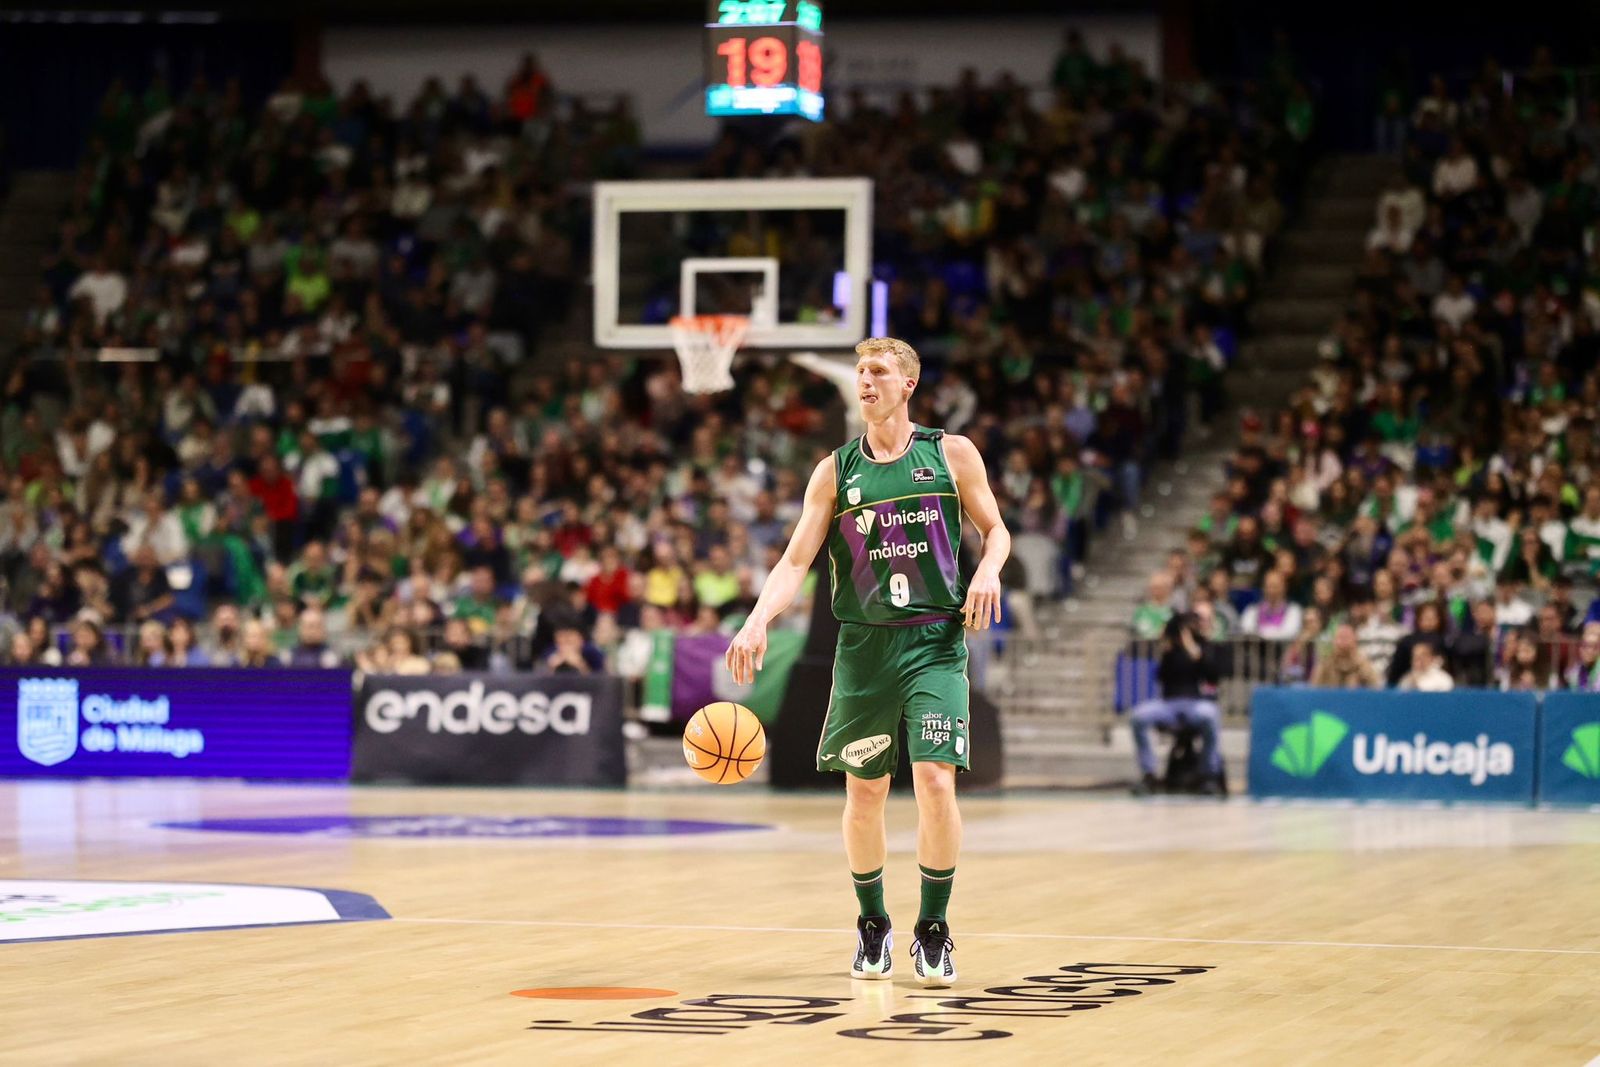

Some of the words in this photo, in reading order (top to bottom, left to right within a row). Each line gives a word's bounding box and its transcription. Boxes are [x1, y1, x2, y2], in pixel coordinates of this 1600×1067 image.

[717, 36, 788, 87] 19
[880, 506, 939, 528] Unicaja
[869, 541, 929, 561] málaga
[889, 573, 910, 608] 9
[81, 693, 170, 724] Ciudad
[364, 679, 593, 735] endesa
[921, 711, 943, 720] sabor
[926, 716, 952, 731] má
[80, 724, 116, 753] de
[116, 724, 205, 758] Málaga
[921, 726, 950, 745] laga
[1352, 731, 1514, 786] Unicaja
[527, 993, 854, 1035] liga
[836, 962, 1218, 1041] endesa
